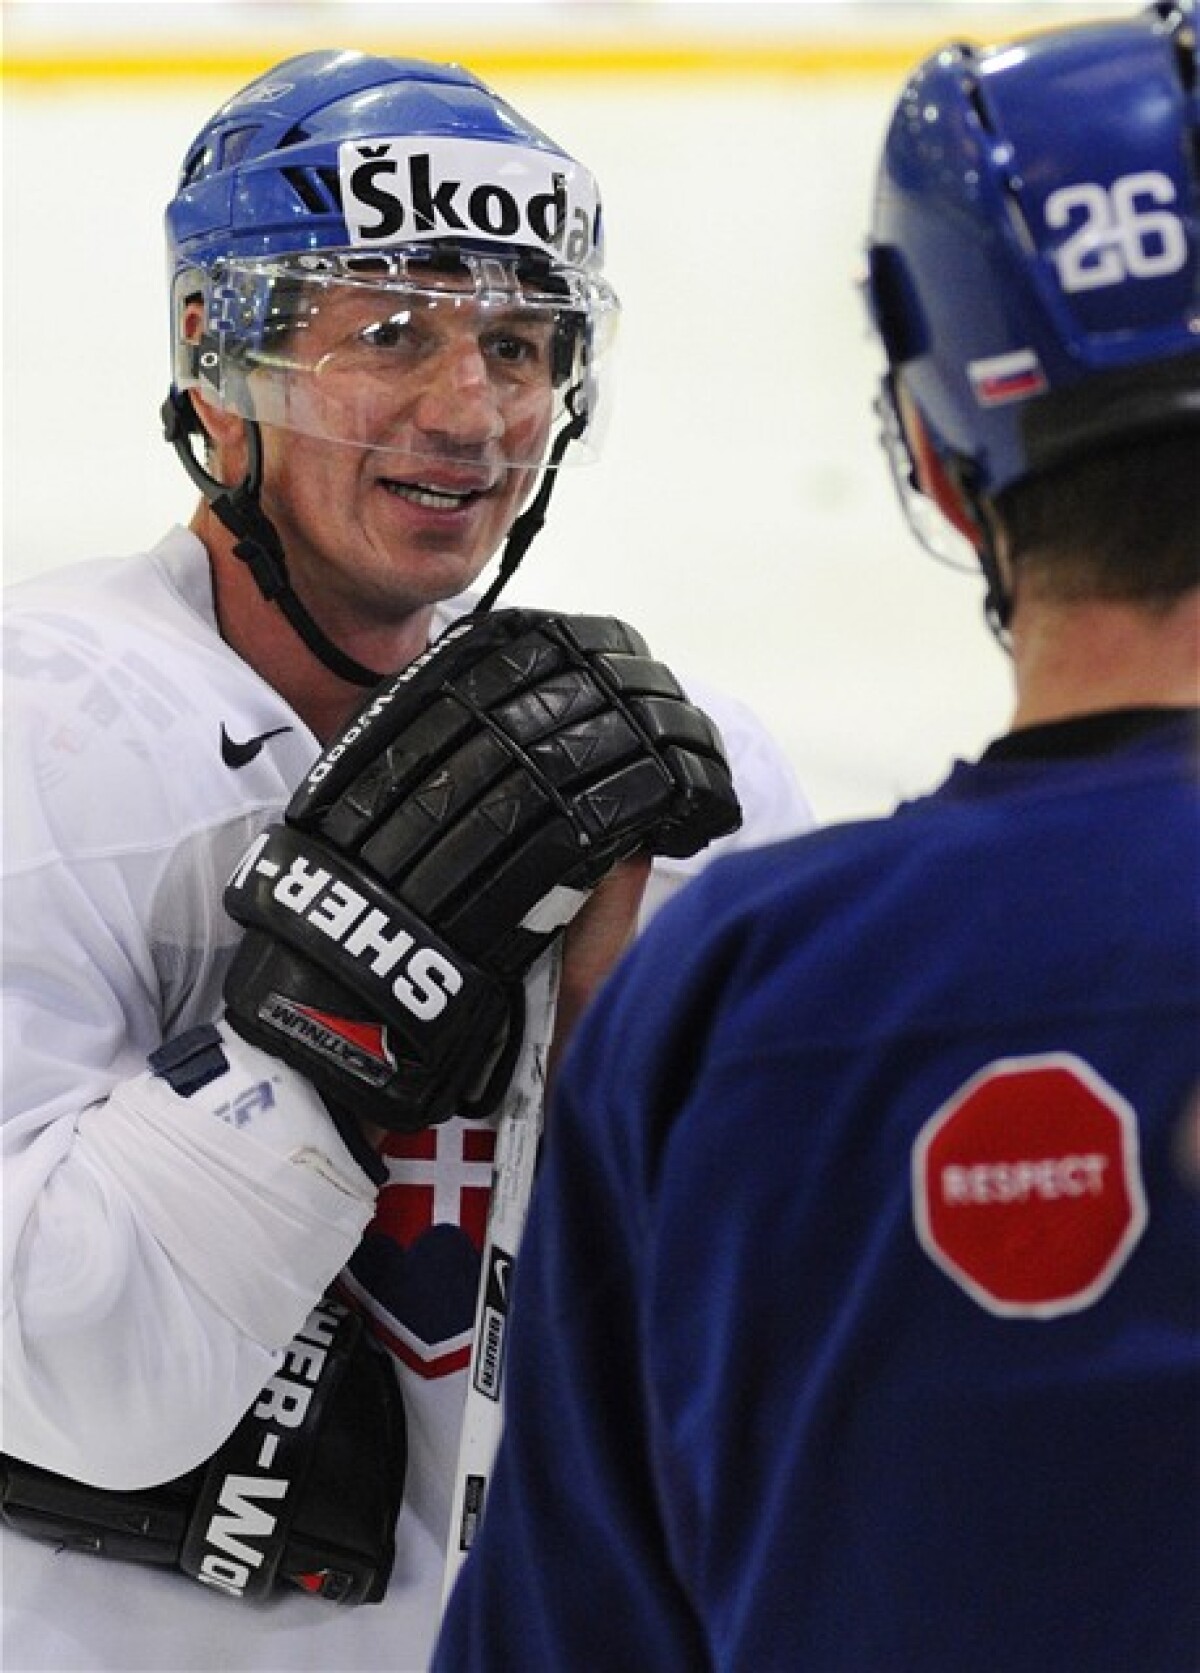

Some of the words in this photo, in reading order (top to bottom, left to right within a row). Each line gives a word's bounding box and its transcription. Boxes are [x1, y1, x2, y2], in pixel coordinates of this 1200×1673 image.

[350, 143, 591, 266] Škoda
[1045, 170, 1189, 294] 26
[942, 1153, 1108, 1206] RESPECT
